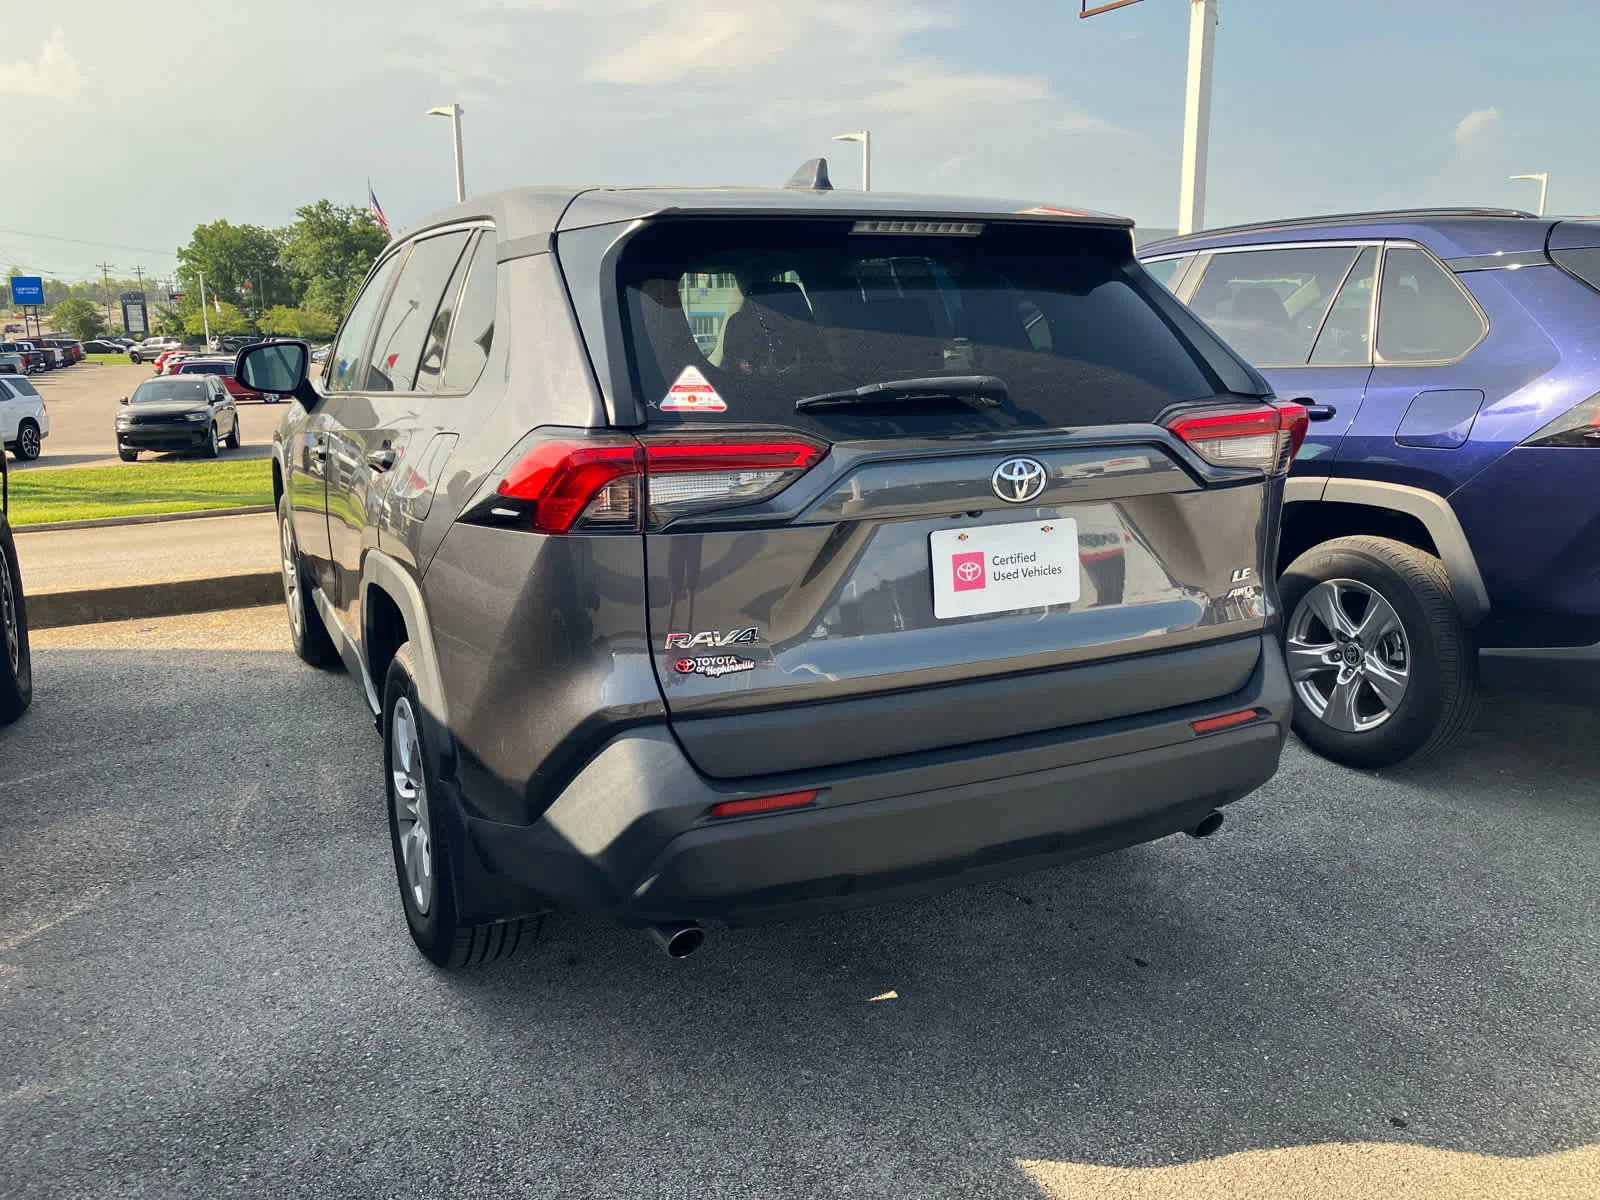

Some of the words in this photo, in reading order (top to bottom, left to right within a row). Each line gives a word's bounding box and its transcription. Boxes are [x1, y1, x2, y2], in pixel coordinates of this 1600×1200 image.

[992, 552, 1036, 566] Certified
[993, 568, 1019, 581] Used
[1021, 565, 1062, 578] Vehicles
[1230, 567, 1251, 583] LE
[665, 627, 759, 649] RAV4
[696, 656, 737, 666] TOYOTA
